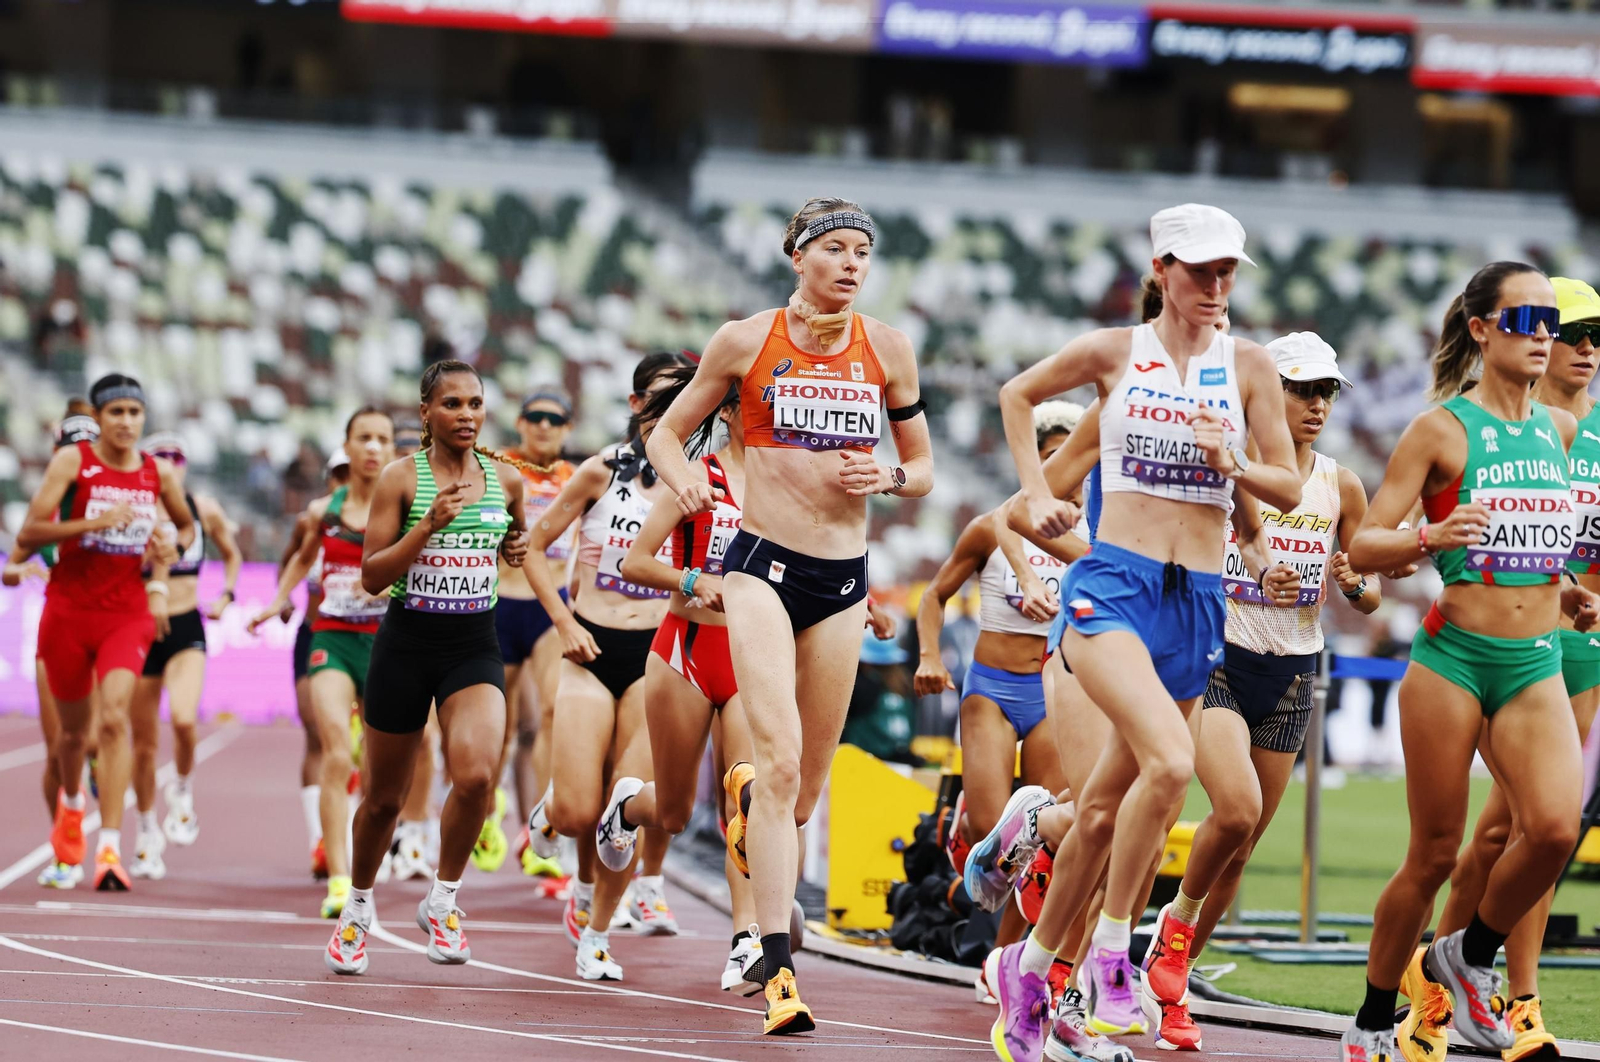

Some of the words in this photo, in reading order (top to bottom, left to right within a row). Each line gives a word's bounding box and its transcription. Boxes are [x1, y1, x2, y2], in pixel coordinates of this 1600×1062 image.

[797, 369, 842, 378] Staatsloterij
[777, 384, 878, 404] HONDA
[780, 407, 874, 435] LUIJTEN
[1126, 403, 1237, 433] HONA
[1476, 459, 1567, 489] PORTUGAL
[1475, 497, 1574, 513] HONDA
[425, 532, 504, 549] ESOTH
[1479, 523, 1572, 548] SANTOS
[413, 555, 495, 568] HONDA
[411, 572, 490, 596] KHATALA
